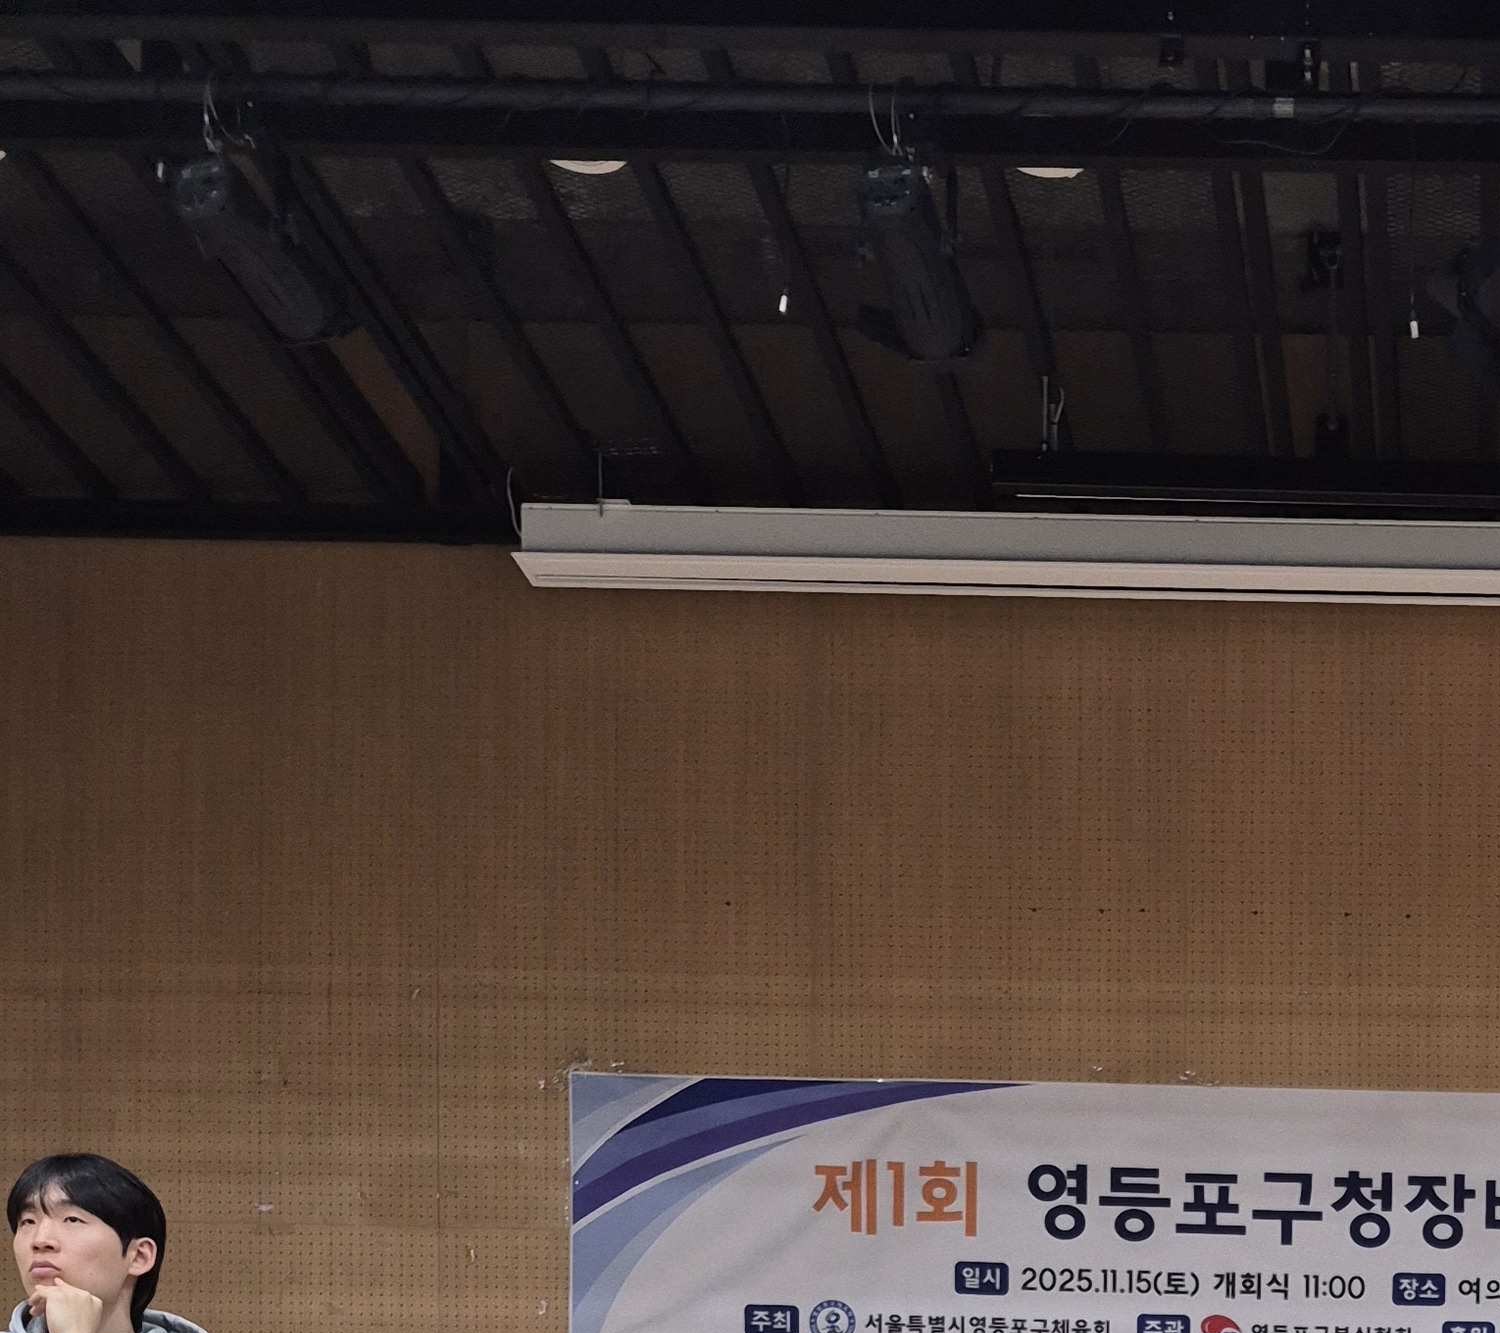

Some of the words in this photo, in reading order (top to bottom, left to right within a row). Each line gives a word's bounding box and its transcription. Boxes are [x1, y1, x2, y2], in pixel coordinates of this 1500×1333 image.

[812, 1159, 979, 1237] 제1회
[962, 1267, 1001, 1290] 일시
[1021, 1267, 1200, 1297] 2025.11.15(토)
[1213, 1272, 1290, 1300] 개회식
[1303, 1274, 1366, 1300] 11:00
[1399, 1279, 1440, 1301] 장소
[751, 1310, 791, 1333] 주최
